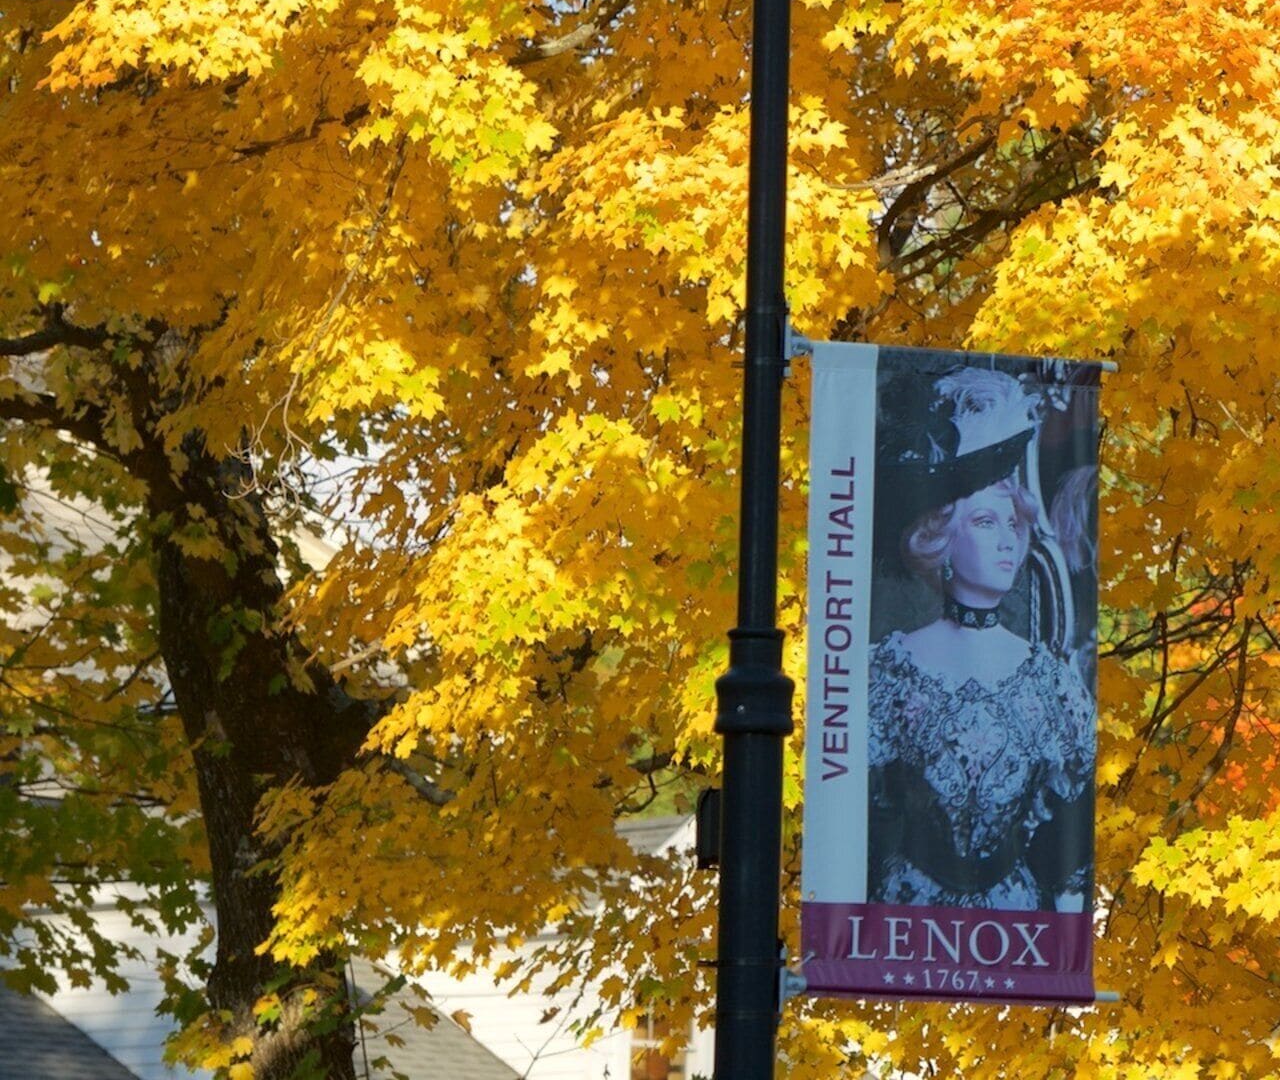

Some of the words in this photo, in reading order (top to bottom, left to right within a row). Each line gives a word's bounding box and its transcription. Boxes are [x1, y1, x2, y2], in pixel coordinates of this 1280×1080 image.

[828, 456, 855, 558] HALL
[822, 570, 853, 781] VENTFORT
[847, 916, 1050, 966] LENOX
[921, 969, 979, 992] 1767
